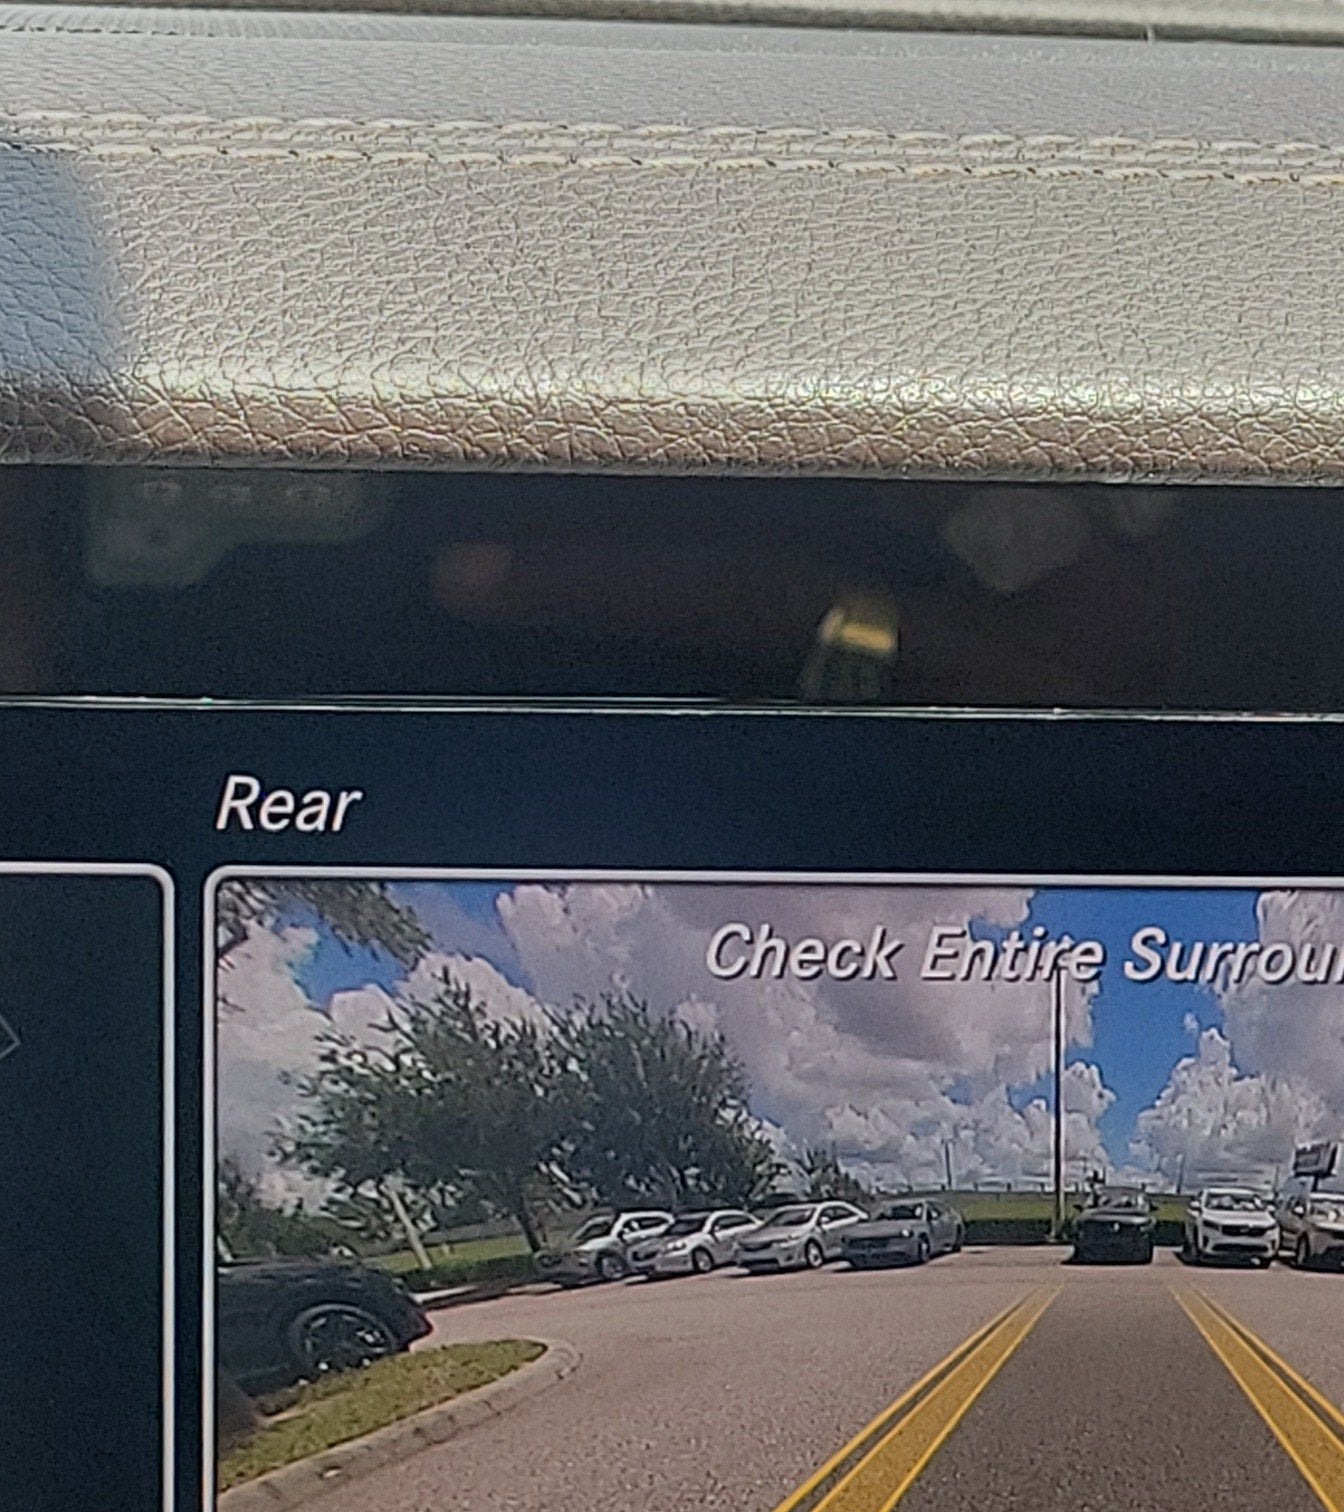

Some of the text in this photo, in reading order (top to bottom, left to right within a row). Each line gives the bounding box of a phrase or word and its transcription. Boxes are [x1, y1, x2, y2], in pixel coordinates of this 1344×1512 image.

[215, 773, 364, 832] Rear
[706, 922, 905, 980] Check
[920, 925, 1106, 982] Entire
